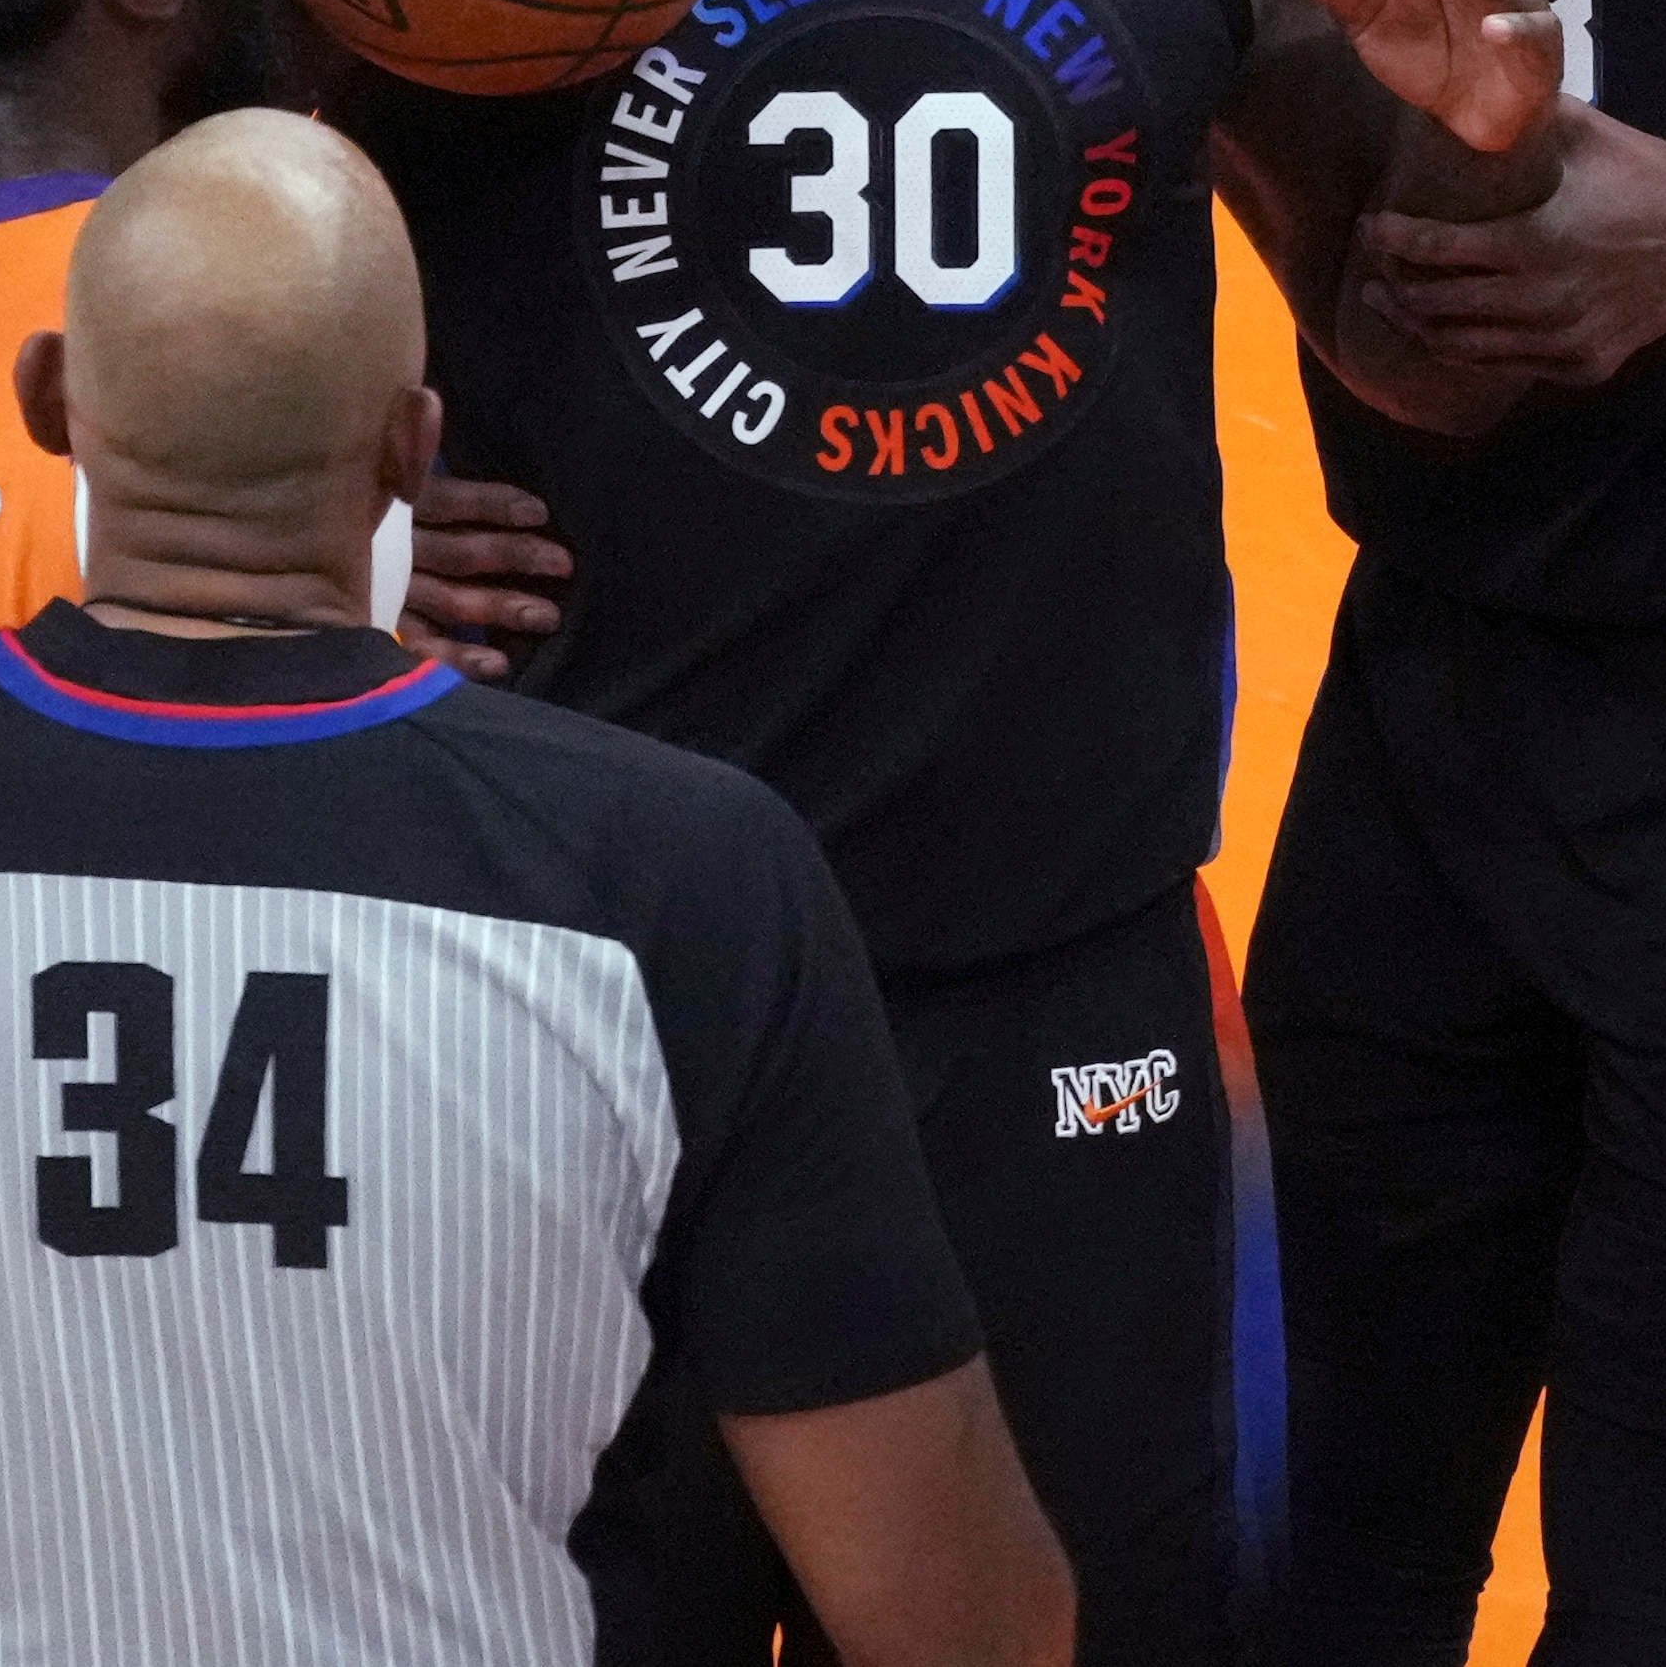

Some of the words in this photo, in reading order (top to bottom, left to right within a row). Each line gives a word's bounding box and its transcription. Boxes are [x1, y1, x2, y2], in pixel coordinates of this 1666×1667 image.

[599, 47, 707, 282] NEVER
[748, 91, 1020, 309] 30
[1059, 130, 1138, 324] YORK
[636, 307, 786, 445] CITY
[816, 334, 1084, 476] KNICKS
[30, 960, 348, 1269] 34
[1051, 1049, 1180, 1137] NYC
